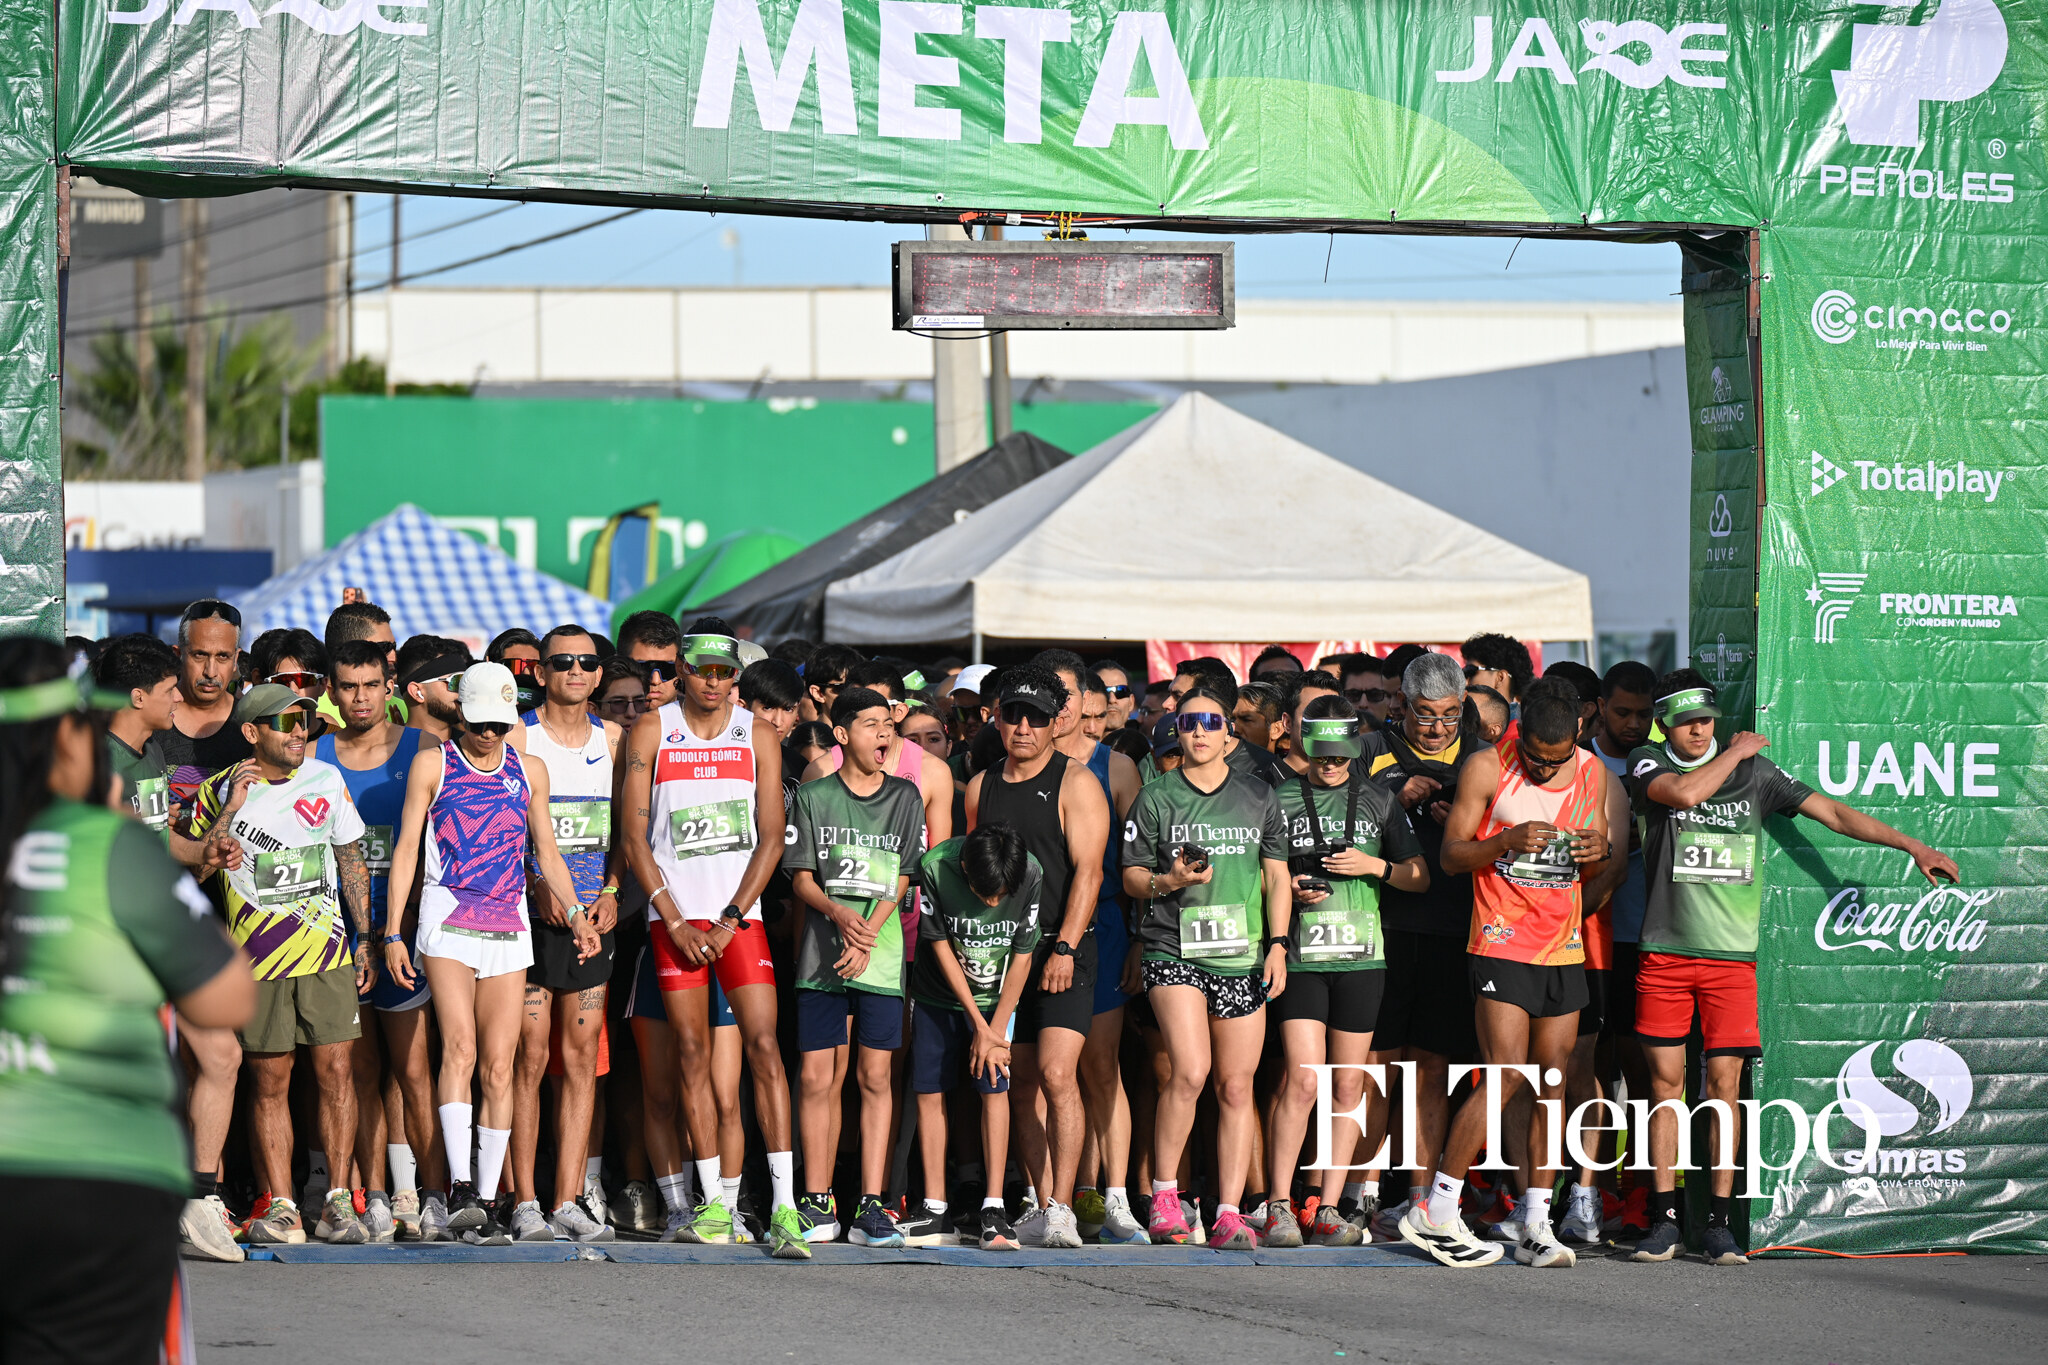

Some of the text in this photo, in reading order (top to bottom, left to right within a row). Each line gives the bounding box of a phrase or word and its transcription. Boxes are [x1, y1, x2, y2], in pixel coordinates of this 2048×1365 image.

[693, 0, 1209, 150] META
[1819, 161, 2015, 204] PEÑOLES
[1875, 338, 1987, 352] Lo Mejor Para Vivir Bien
[1700, 404, 1744, 425] GLAMPING
[1706, 546, 1734, 562] nuve
[1880, 593, 2018, 616] FRONTERA
[1700, 649, 1717, 663] Santa
[669, 748, 742, 763] RODOLFO GÓMEZ
[693, 766, 718, 778] CLUB
[1818, 740, 2000, 796] UANE
[681, 816, 731, 843] 225
[739, 810, 749, 844] MEDALLA
[1293, 816, 1311, 836] El
[1688, 811, 1737, 828] todos
[235, 820, 283, 852] EL LÍMITE
[817, 826, 901, 849] El Tiempo
[1170, 823, 1261, 844] El Tiempo
[1683, 845, 1733, 868] 314
[1744, 846, 1753, 880] MEDALLA
[273, 862, 305, 887] 27
[838, 858, 870, 881] 22
[888, 864, 898, 897] MEDALLA
[1814, 884, 2000, 952] Coca-Cola
[962, 936, 1012, 948] todos
[1191, 919, 1239, 942] 118
[1309, 924, 1357, 946] 218
[1366, 921, 1374, 955] MEDALLA
[1843, 1148, 1967, 1174] simas
